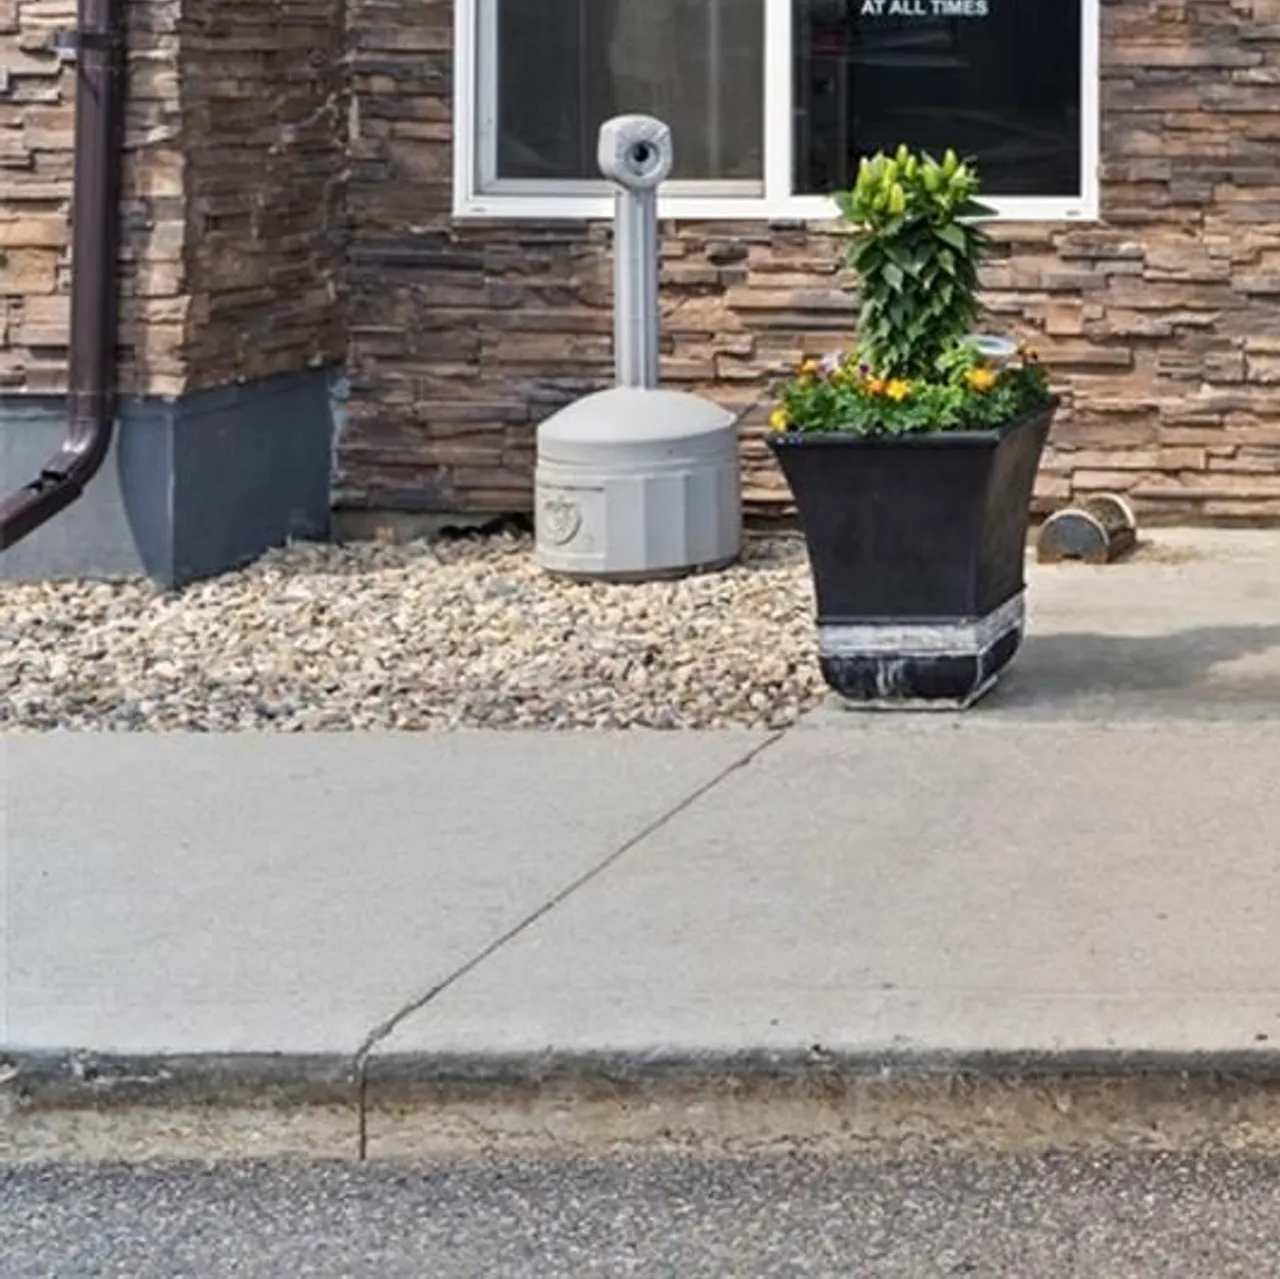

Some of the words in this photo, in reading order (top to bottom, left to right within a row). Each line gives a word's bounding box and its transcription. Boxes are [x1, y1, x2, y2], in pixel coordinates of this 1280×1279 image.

[861, 0, 885, 15] AT
[888, 0, 926, 15] ALL
[930, 0, 988, 15] TIMES
